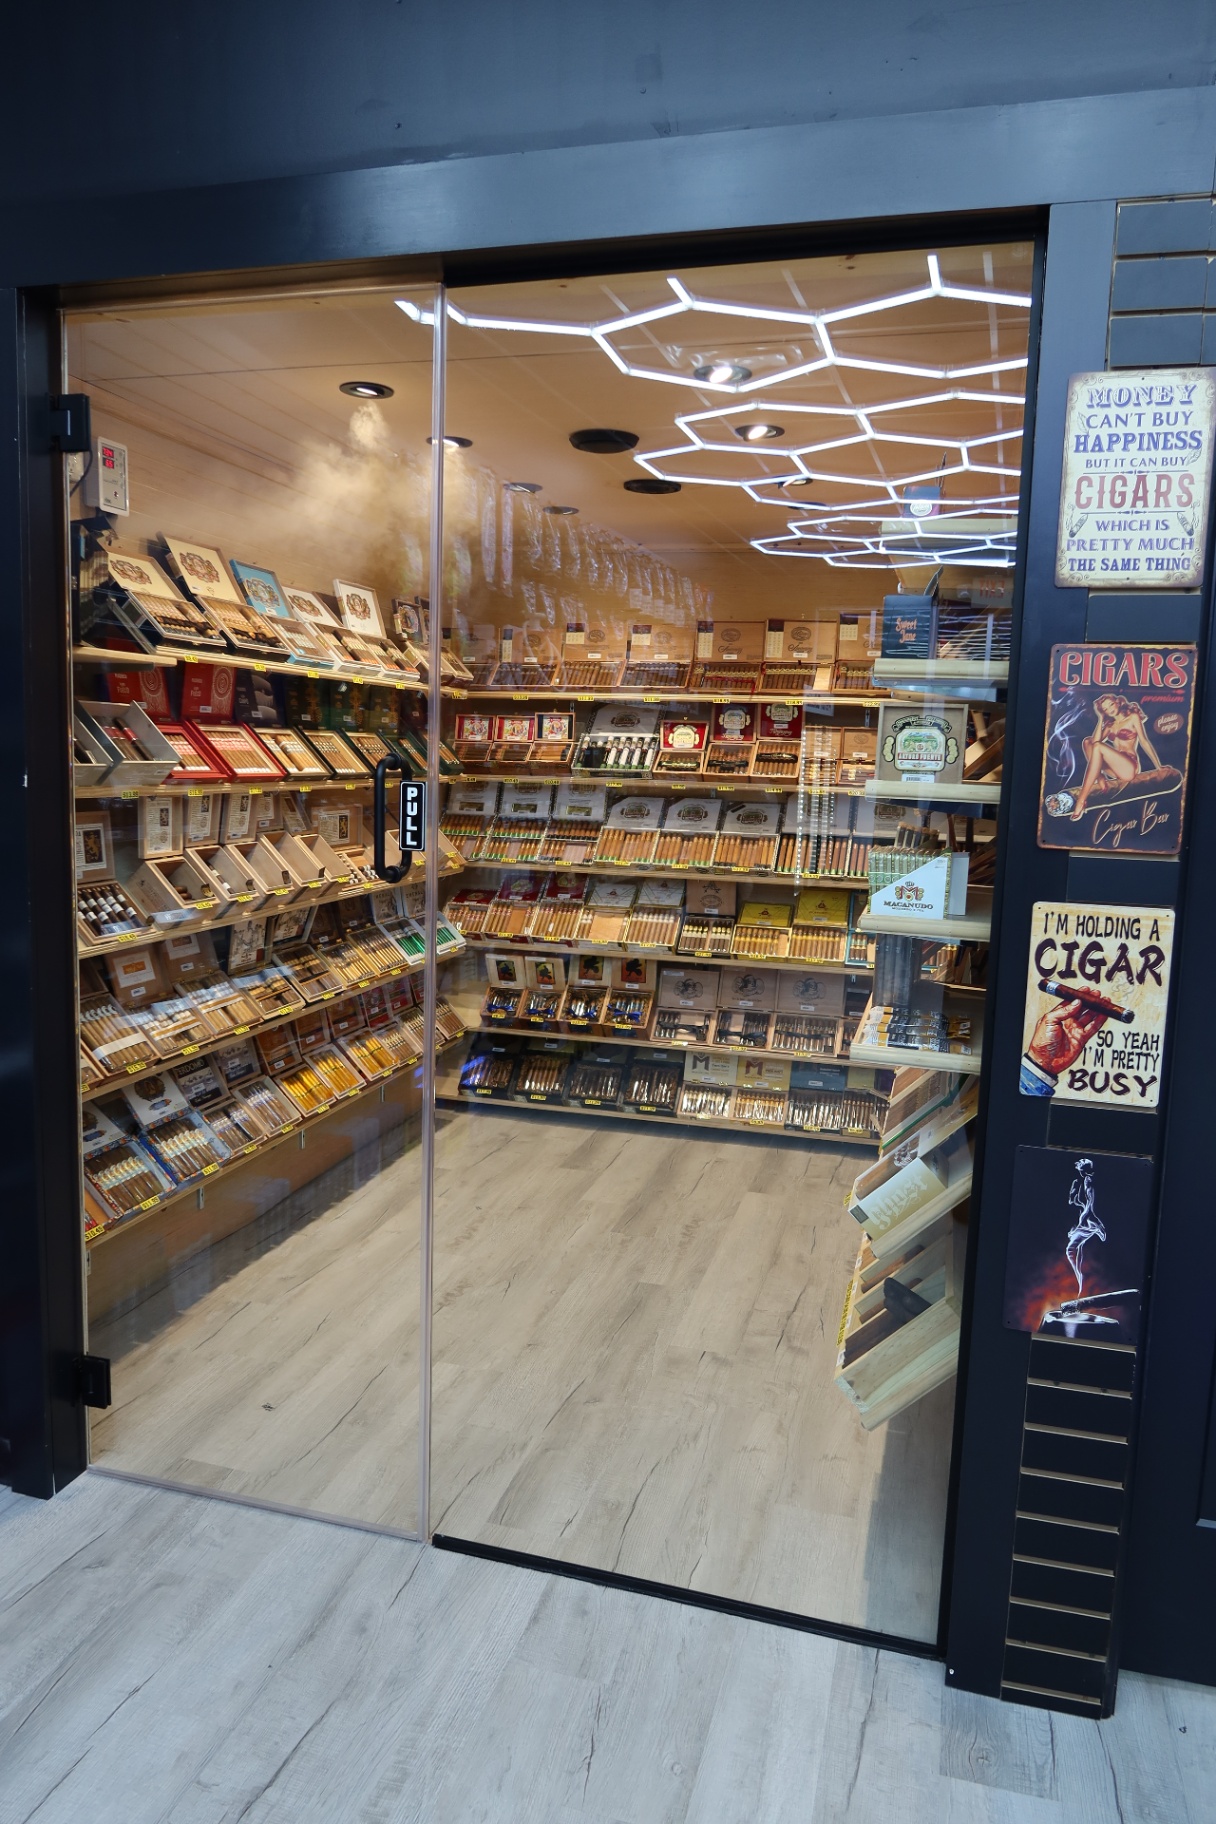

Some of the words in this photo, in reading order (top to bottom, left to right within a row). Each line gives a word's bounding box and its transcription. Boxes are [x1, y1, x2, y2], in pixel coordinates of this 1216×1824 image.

[1086, 384, 1197, 408] MONEY
[1085, 412, 1146, 429] CAN'T
[1152, 411, 1193, 427] BUY
[1073, 430, 1203, 453] HAPPINESS
[1085, 458, 1110, 468] BUT
[1114, 458, 1126, 468] IT
[1130, 457, 1157, 467] CAN
[1161, 456, 1188, 466] BUY
[1074, 473, 1196, 509] CIGARS
[1095, 519, 1151, 532] WHICH
[1155, 519, 1170, 531] IS
[1066, 538, 1133, 551] PRETTY
[1137, 537, 1195, 551] MUCH
[1068, 558, 1096, 572] THE
[1100, 558, 1140, 571] SAME
[1145, 558, 1191, 571] THING
[895, 617, 918, 632] Sweet
[899, 630, 917, 644] Jane
[1058, 651, 1189, 688] CIGARS
[1141, 694, 1184, 704] premium
[1157, 714, 1178, 727] please
[1160, 721, 1179, 733] enjoy
[406, 787, 418, 846] PULL
[1092, 809, 1138, 848] Cigar
[1140, 800, 1170, 836] Bar
[883, 900, 934, 910] MACANUDO
[1043, 911, 1068, 935] I'M
[1076, 915, 1141, 940] HOLDING
[1149, 919, 1160, 941] A
[1034, 937, 1166, 986] CIGAR
[1096, 1030, 1114, 1048] SO
[1122, 1031, 1160, 1052] YEAH
[1082, 1046, 1104, 1069] I'M
[1110, 1049, 1160, 1072] PRETTY
[1067, 1068, 1158, 1098] BUSY
